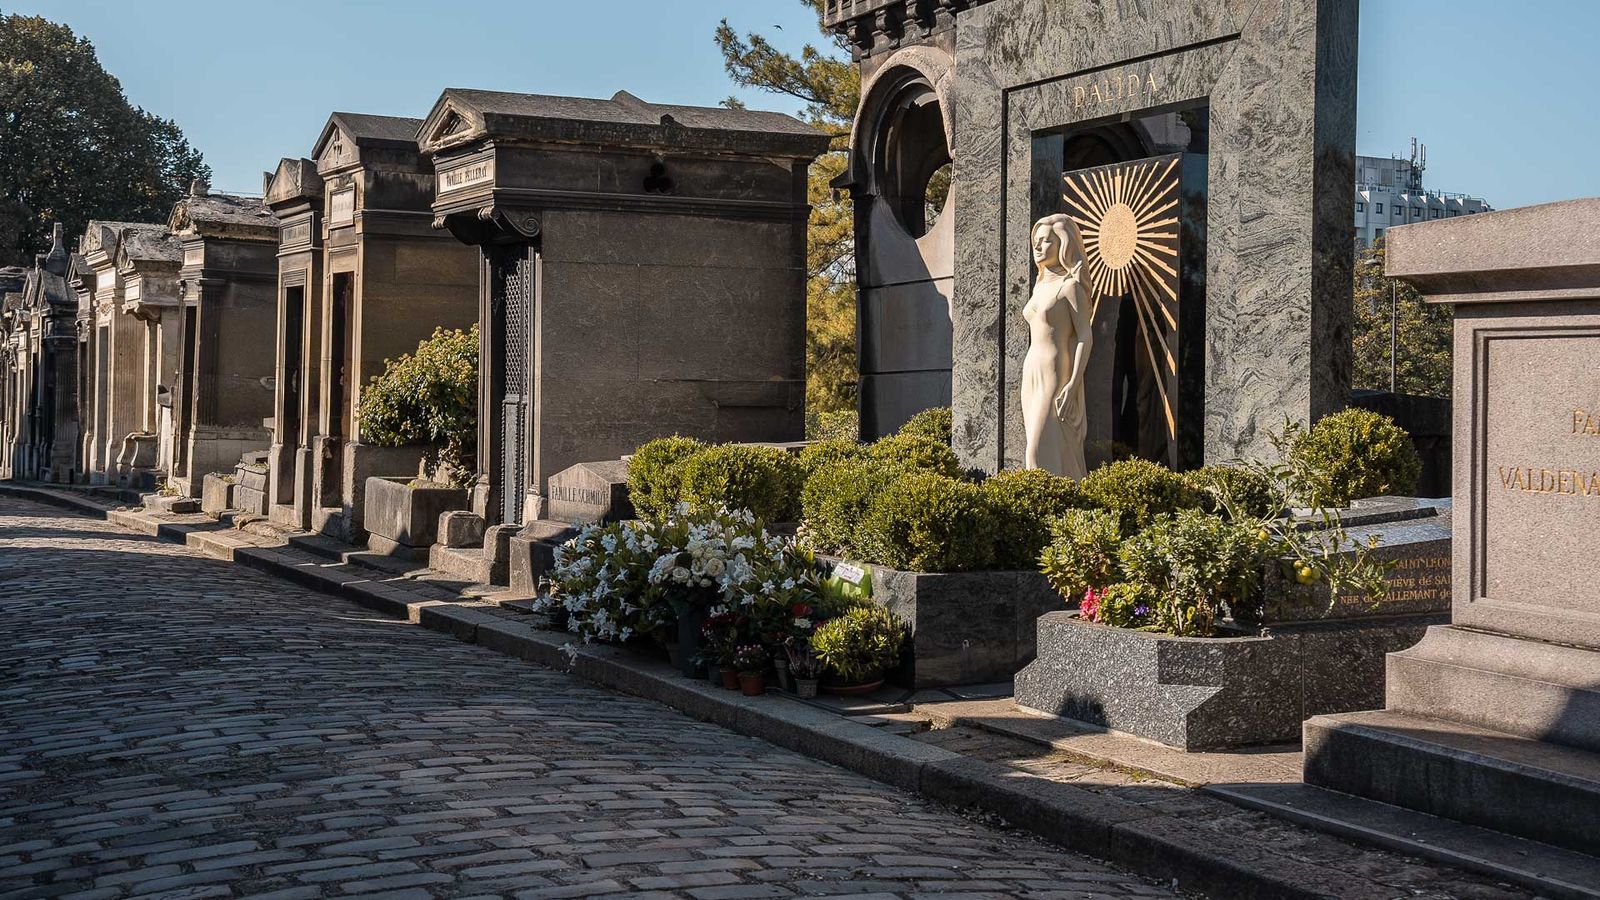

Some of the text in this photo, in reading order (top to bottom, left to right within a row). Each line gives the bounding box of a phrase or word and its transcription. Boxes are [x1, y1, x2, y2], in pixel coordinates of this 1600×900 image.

[1074, 73, 1157, 108] DALIDA
[1571, 408, 1600, 435] FA
[1499, 466, 1600, 497] VALDENA
[552, 485, 608, 506] FAMILLE SCHMIDT
[1419, 576, 1432, 586] de
